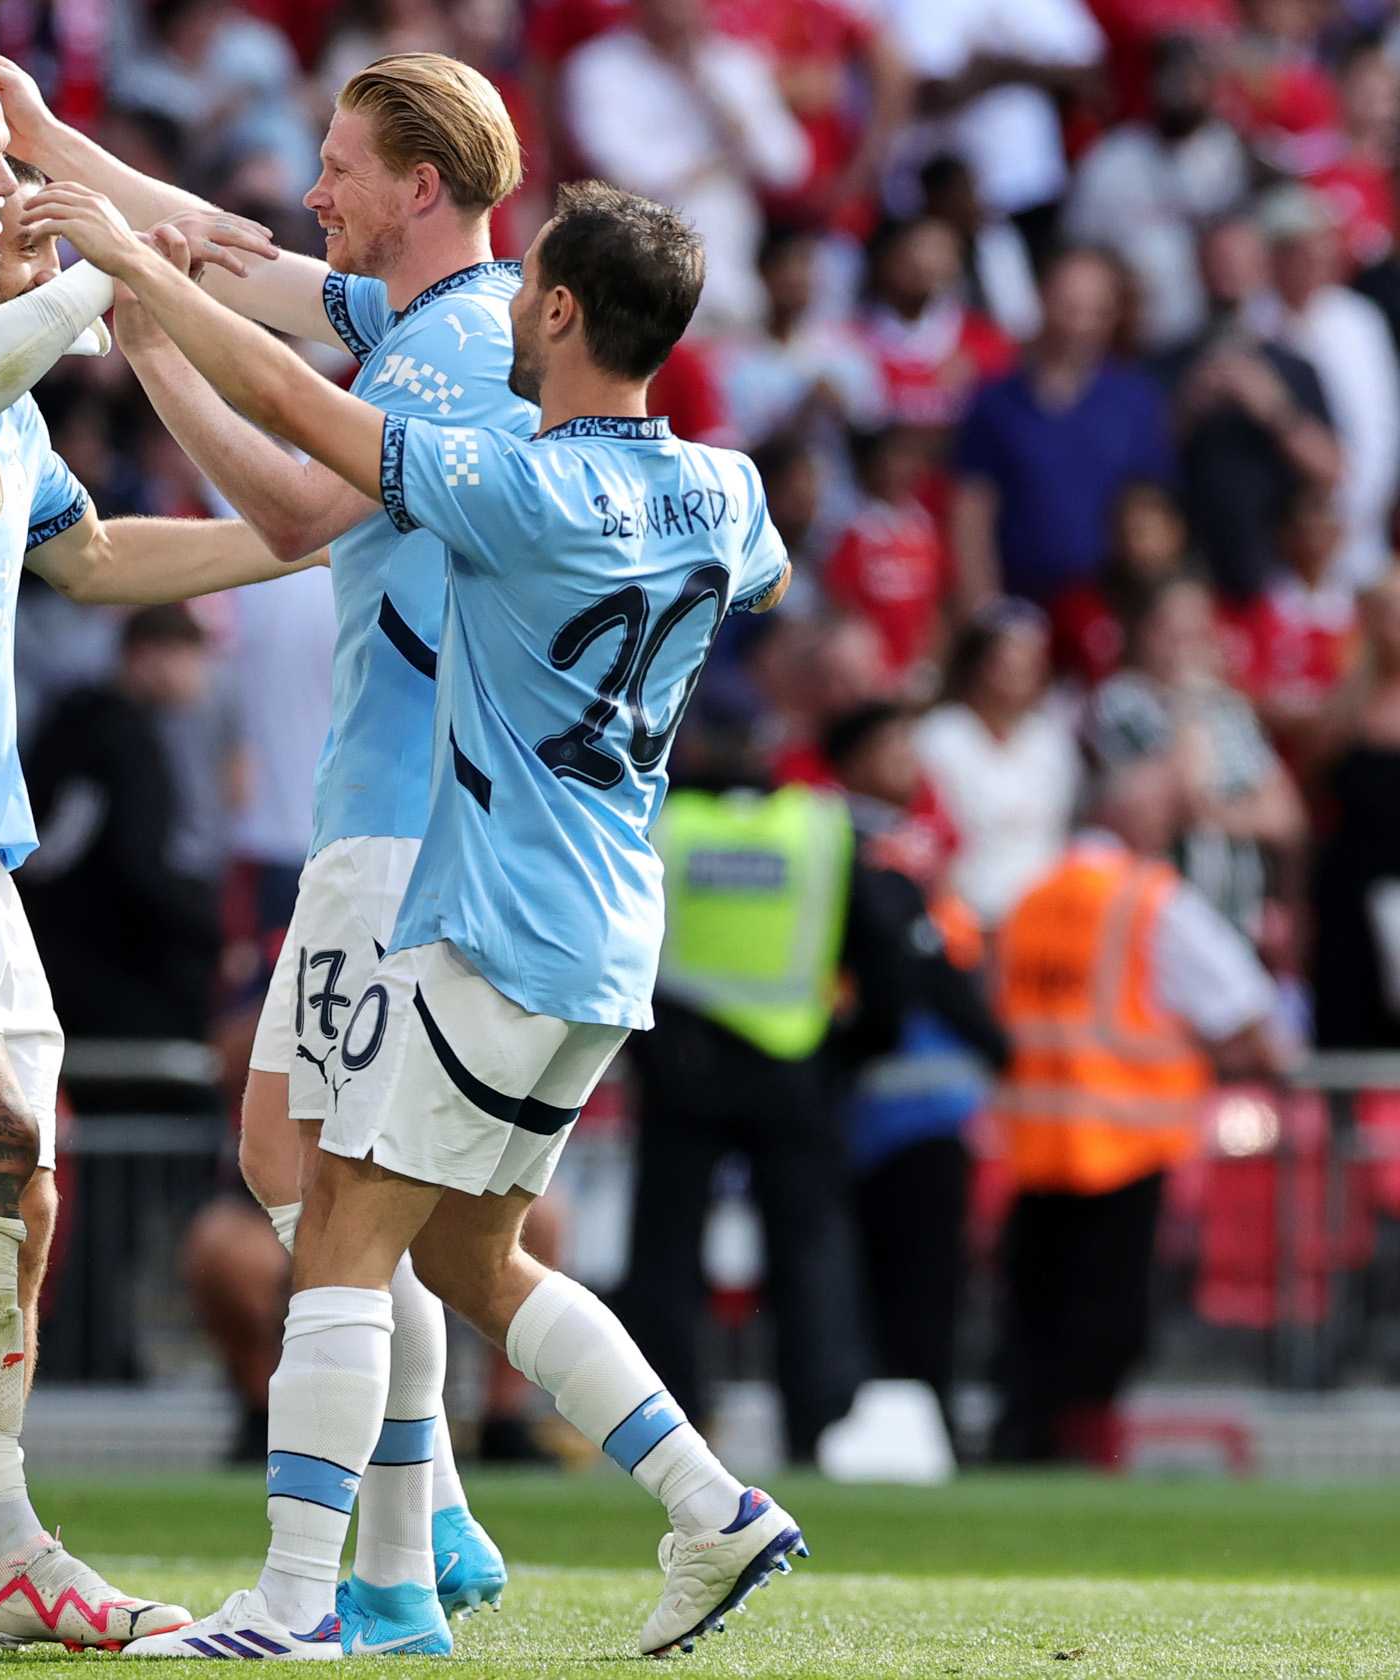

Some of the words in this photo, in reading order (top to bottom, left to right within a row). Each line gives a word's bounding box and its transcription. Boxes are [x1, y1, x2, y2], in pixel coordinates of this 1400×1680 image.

[594, 488, 740, 539] BERNARDO
[534, 561, 732, 791] 20
[295, 946, 351, 1040] 17
